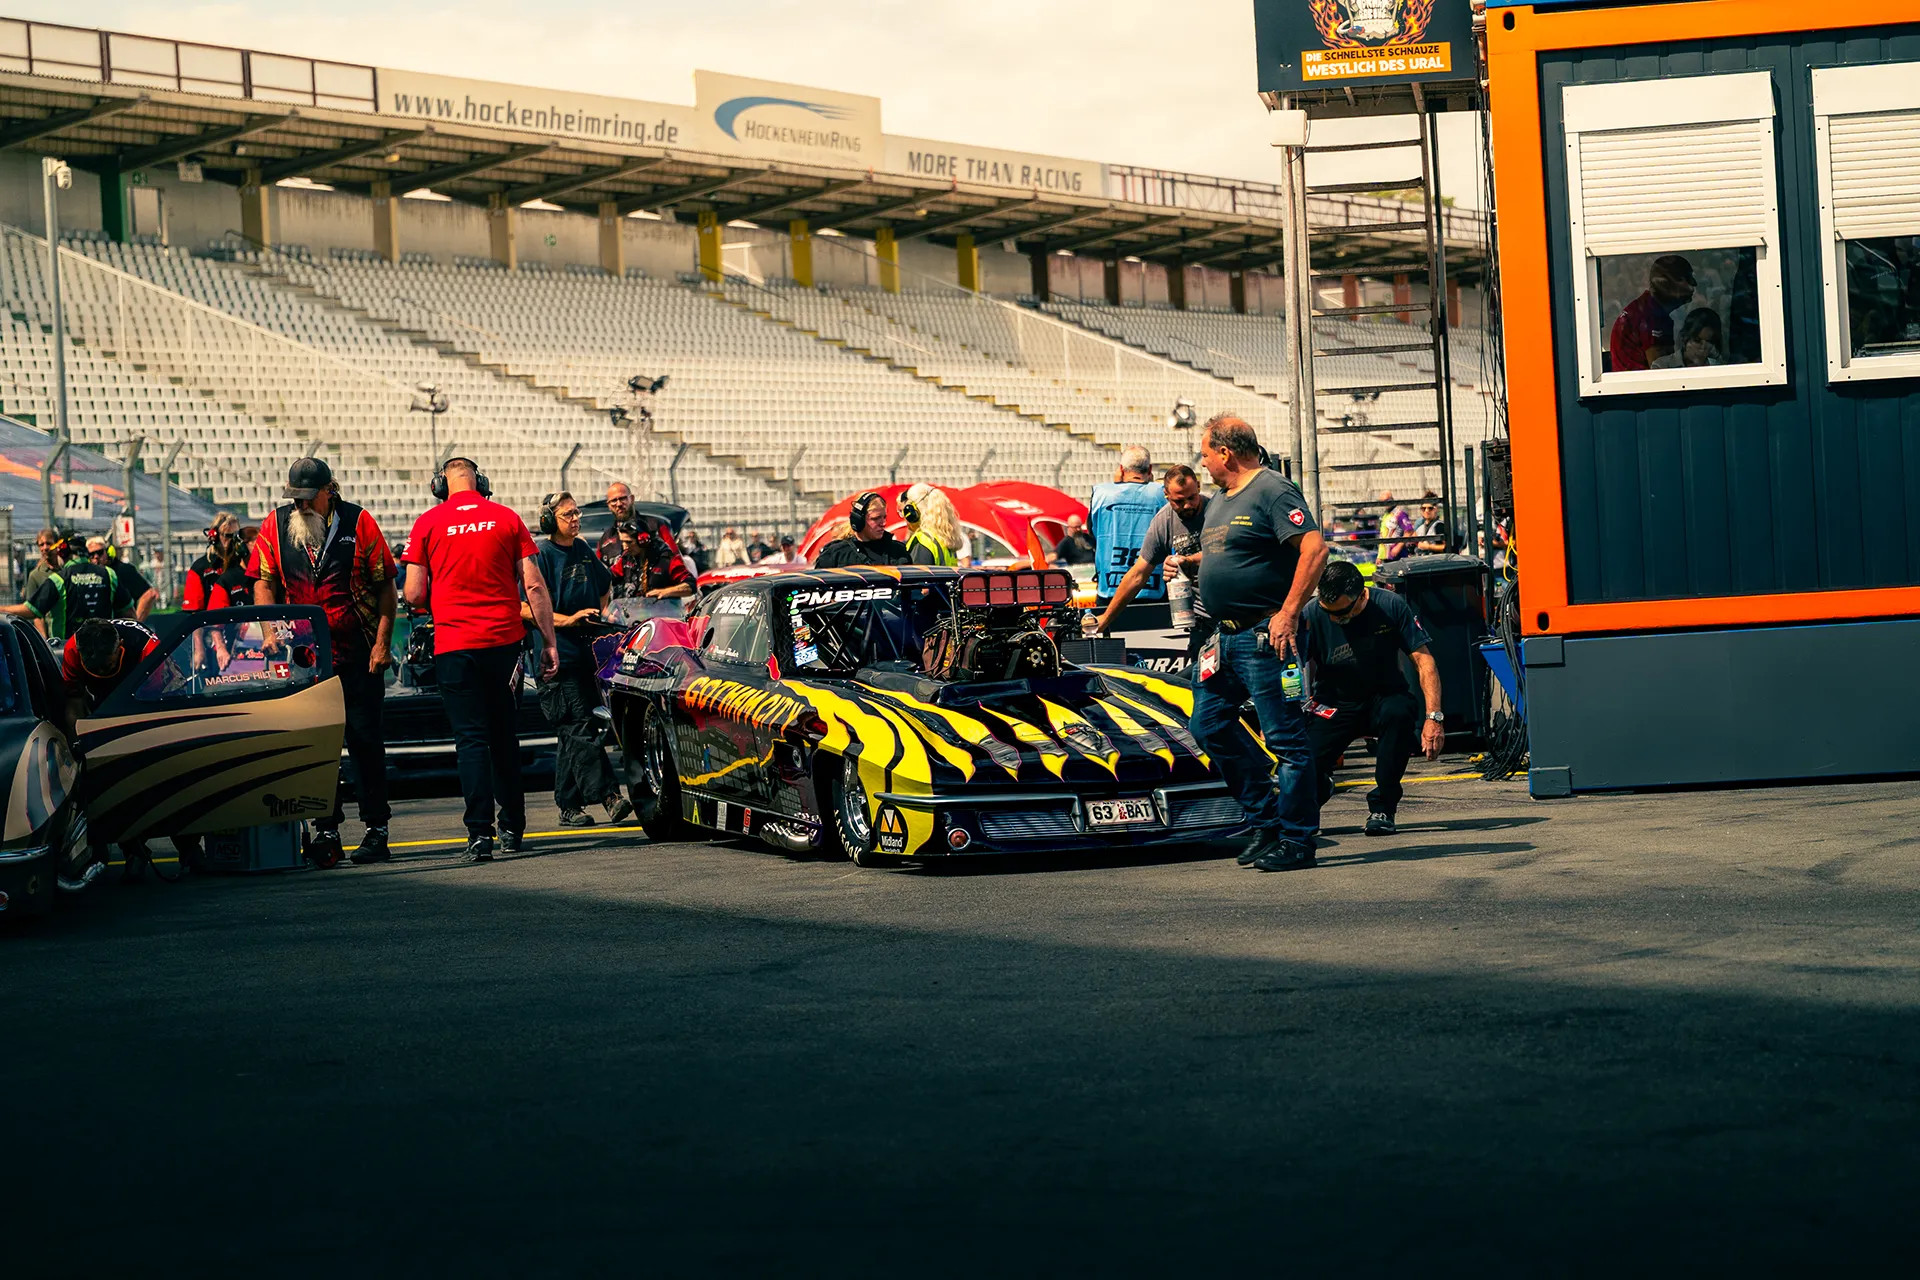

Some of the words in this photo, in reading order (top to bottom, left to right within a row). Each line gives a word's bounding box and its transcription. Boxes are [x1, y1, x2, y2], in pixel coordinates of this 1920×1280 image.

[1305, 53, 1322, 62] DIE
[1324, 49, 1385, 61] SCHNELLSTE
[1388, 45, 1440, 57] SCHNAUZE
[1306, 61, 1376, 77] WESTLICH
[1379, 59, 1405, 72] DES
[1409, 56, 1445, 70] URAL
[394, 93, 679, 145] www.hockenheimring.de
[907, 151, 957, 176] MORE
[966, 158, 1014, 184] THAN
[1020, 165, 1082, 192] RACING
[63, 494, 89, 510] 17.1
[447, 521, 496, 536] STAFF
[275, 631, 295, 640] 24
[1143, 656, 1192, 673] DRA
[204, 673, 250, 686] MARCUS
[253, 671, 271, 680] HILT
[1092, 805, 1113, 820] 63
[1126, 804, 1150, 818] BAT
